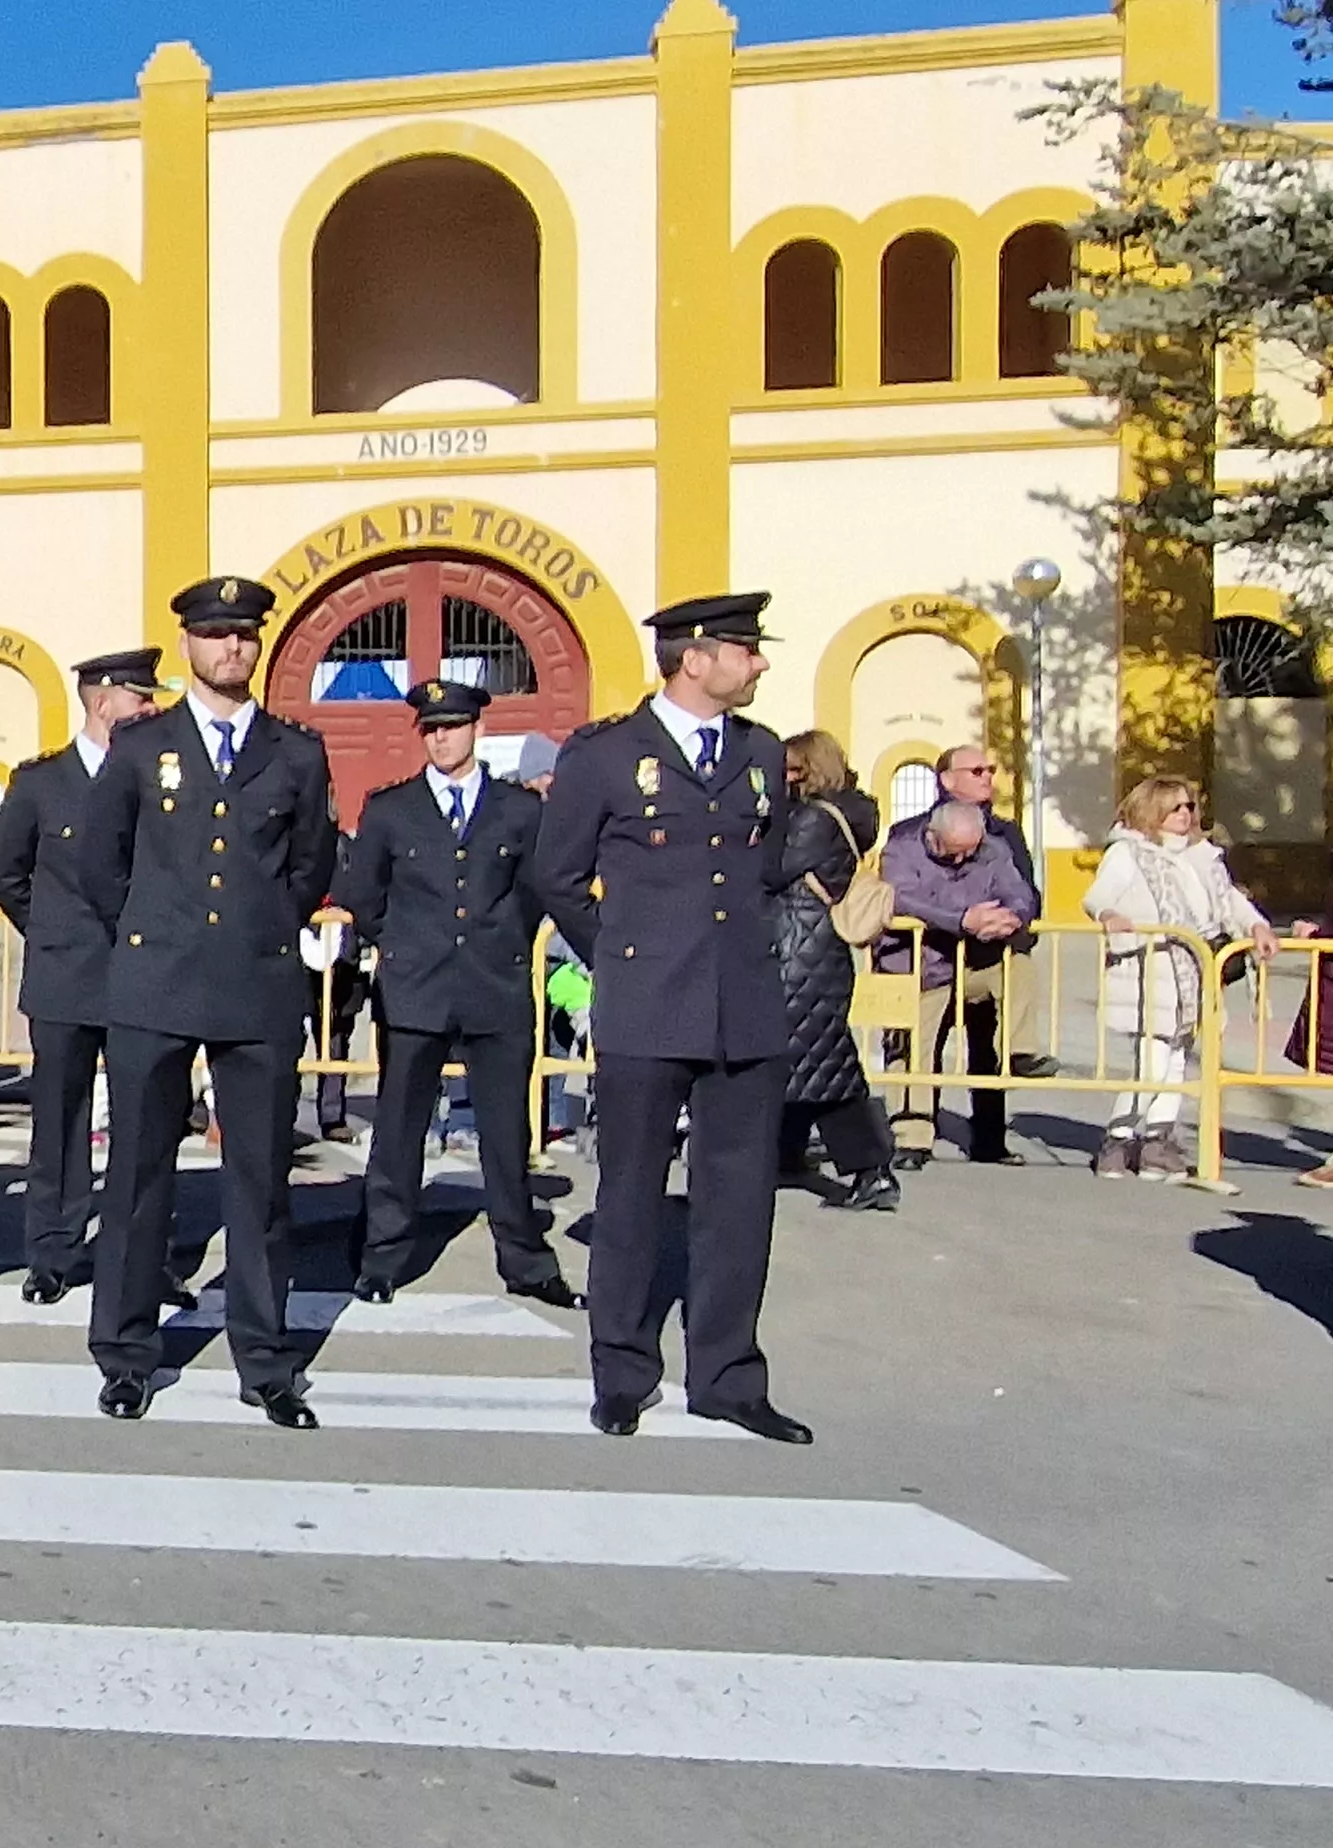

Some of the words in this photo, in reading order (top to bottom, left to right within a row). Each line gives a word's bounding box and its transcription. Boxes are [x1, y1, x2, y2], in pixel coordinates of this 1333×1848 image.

[271, 515, 385, 608] LAZA
[397, 503, 454, 538] DE
[471, 508, 599, 599] TOROS
